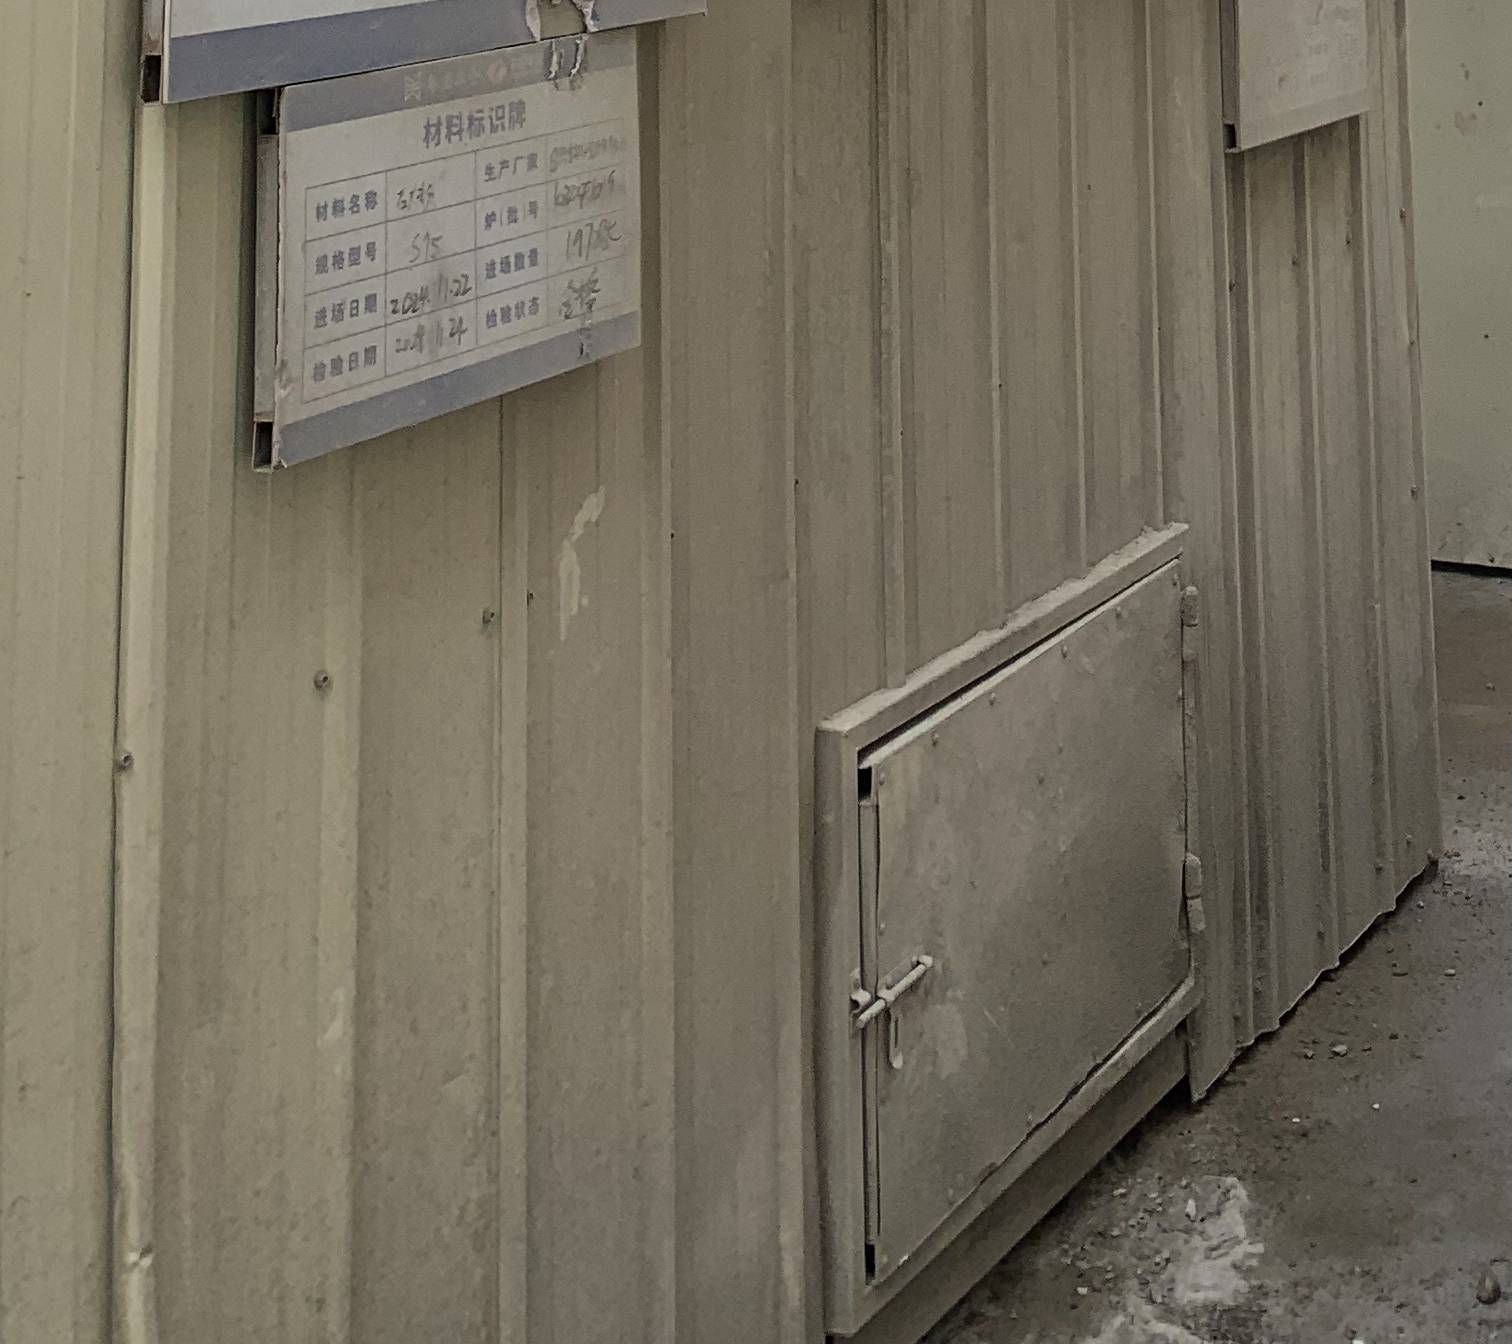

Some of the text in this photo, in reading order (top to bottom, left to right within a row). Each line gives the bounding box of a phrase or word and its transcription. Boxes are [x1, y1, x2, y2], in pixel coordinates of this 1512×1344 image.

[423, 100, 526, 149] 材料标识牌
[315, 190, 378, 223] 材料名称
[315, 241, 378, 275] 规格型号
[314, 294, 378, 328] 进场日期
[312, 346, 378, 381] 检验日期
